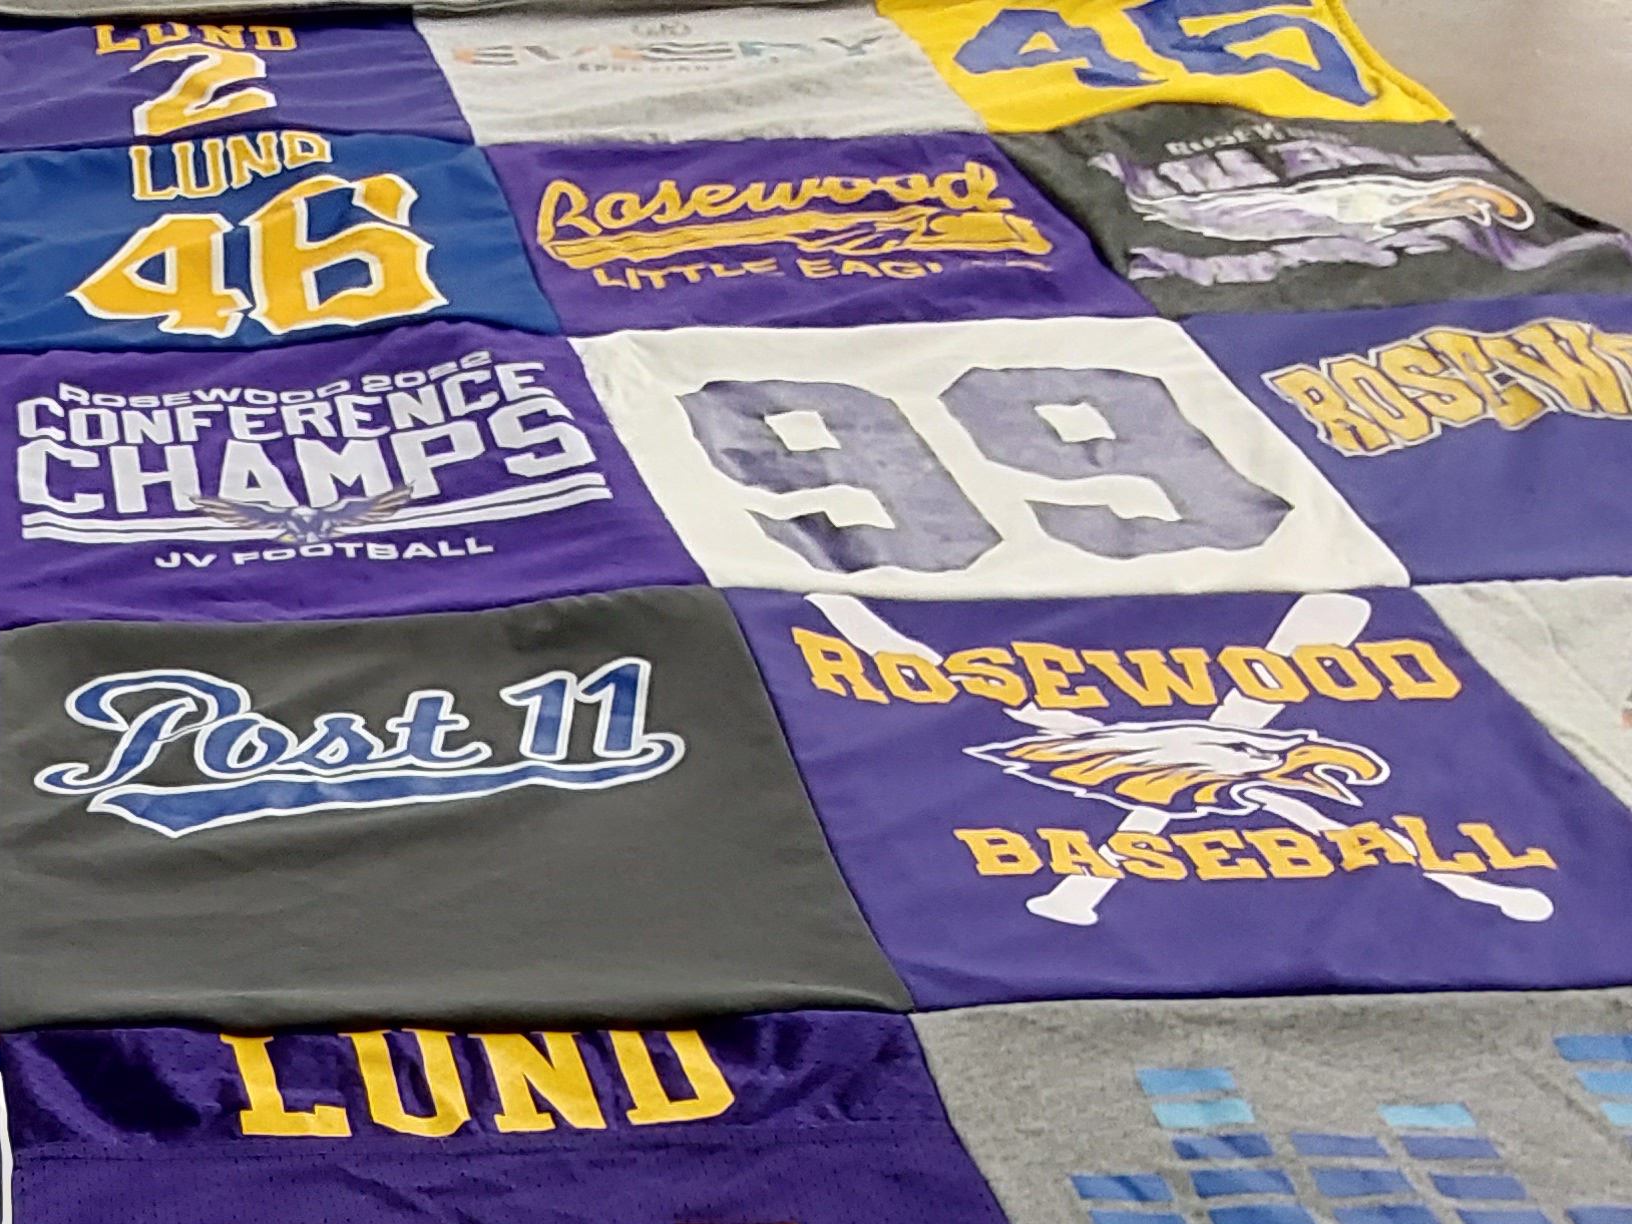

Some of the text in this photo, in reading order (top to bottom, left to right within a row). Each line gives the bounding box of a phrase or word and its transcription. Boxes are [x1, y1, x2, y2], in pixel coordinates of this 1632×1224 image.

[93, 22, 297, 55] LUND
[129, 43, 278, 137] 2
[129, 130, 333, 201] LUND
[536, 160, 1014, 244] Rosewood
[67, 174, 449, 337] 46
[594, 257, 785, 290] LITTLE
[16, 360, 547, 446] CONFERENCE
[58, 381, 351, 408] ROSEWOOD
[1260, 316, 1632, 458] ROSEW
[16, 395, 599, 515] CHAMPS
[675, 366, 1295, 574] 99
[154, 537, 494, 570] JV FOOTBALL
[791, 625, 1464, 711] ROSEWOOD
[34, 656, 654, 795] Post 11
[954, 814, 1558, 881] BASEBALL
[221, 1028, 736, 1138] LUND
